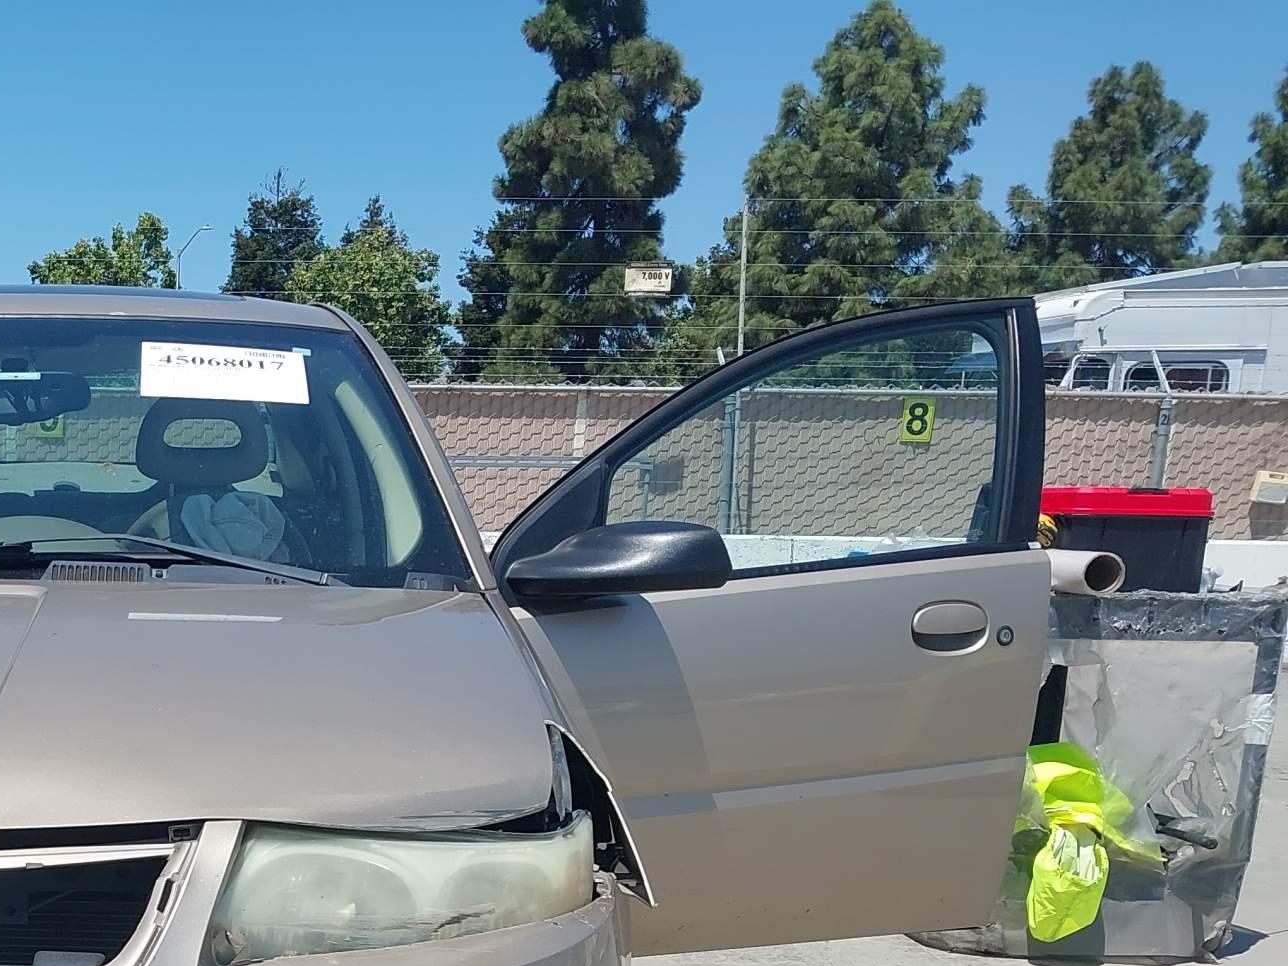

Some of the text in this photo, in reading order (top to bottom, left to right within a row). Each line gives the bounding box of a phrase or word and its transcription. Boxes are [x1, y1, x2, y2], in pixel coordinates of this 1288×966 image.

[641, 271, 670, 281] 7,000 V
[158, 353, 285, 371] 45068017
[906, 402, 929, 435] 8
